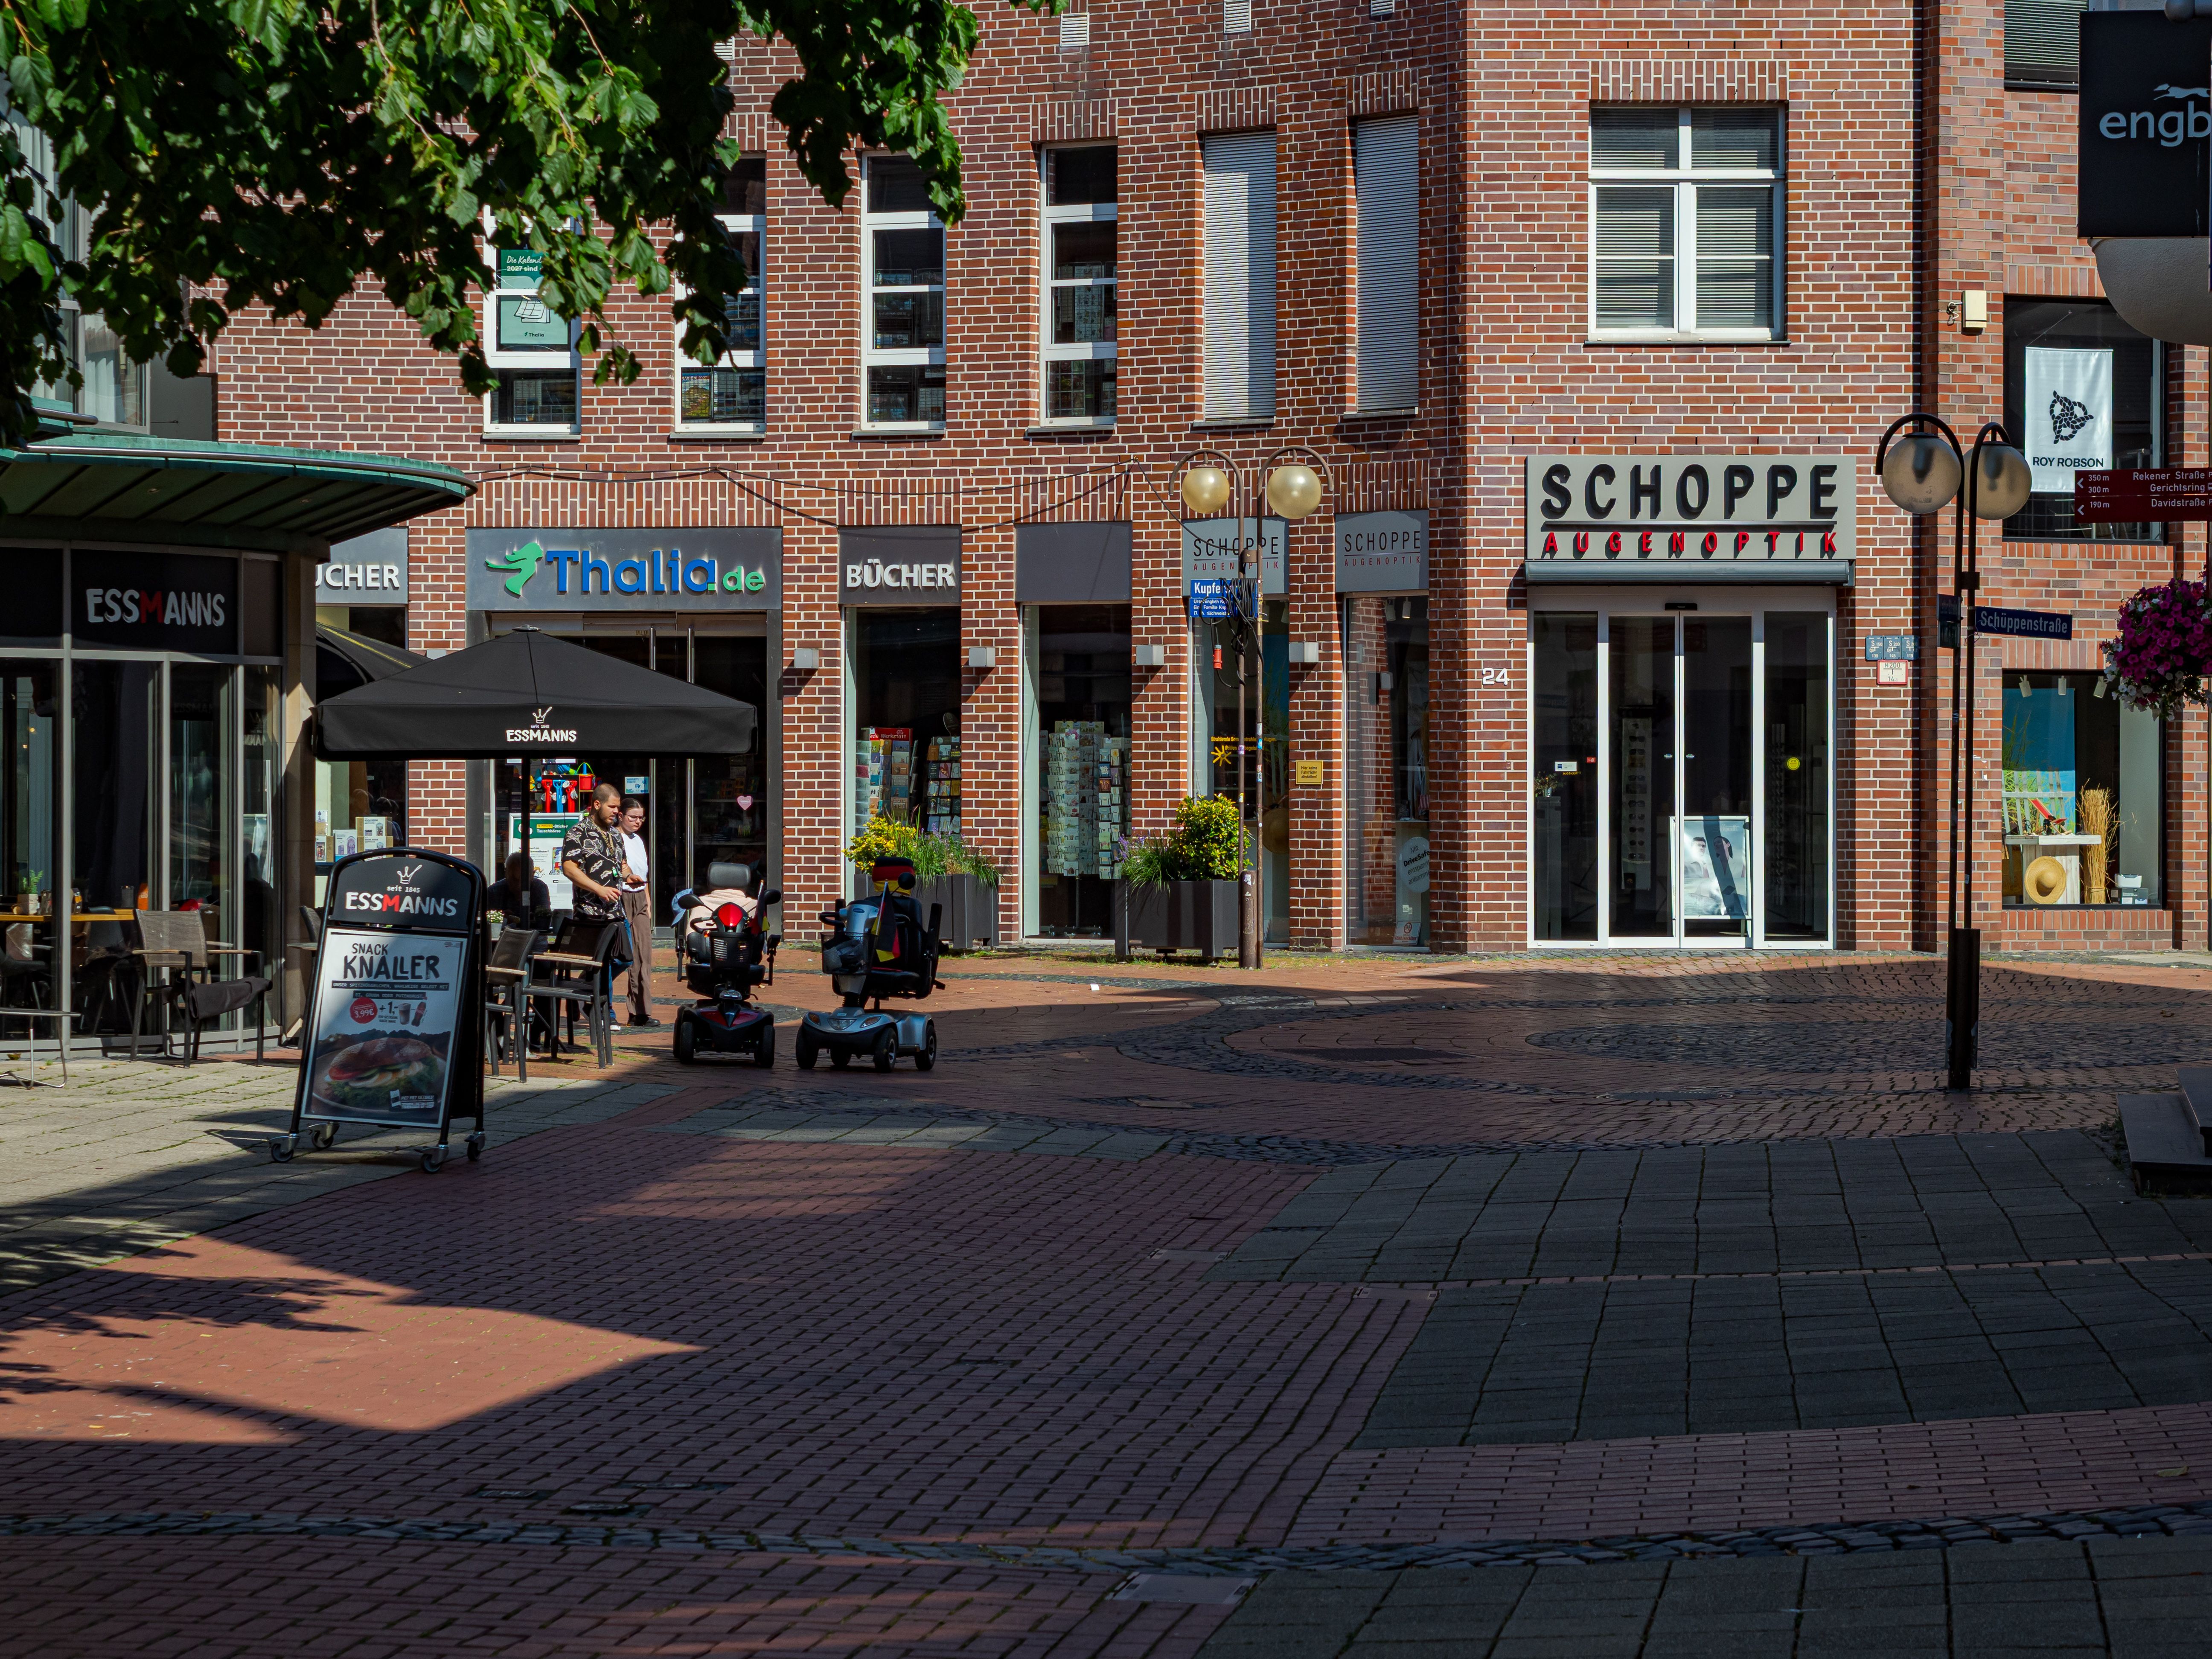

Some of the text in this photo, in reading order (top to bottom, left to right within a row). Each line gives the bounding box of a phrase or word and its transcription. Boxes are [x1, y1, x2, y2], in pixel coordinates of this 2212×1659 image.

[518, 256, 542, 264] Kalend
[2032, 457, 2104, 468] ROY ROBSON
[2133, 472, 2171, 480] Rekener
[2175, 471, 2205, 479] Straße
[1542, 463, 1838, 515] SCHOPPE
[2150, 483, 2205, 493] Gerichtsring
[2151, 498, 2205, 507] Davidstraße
[1344, 531, 1420, 552] SCHOPPE
[1545, 532, 1837, 553] AUGENOPTIK
[1193, 561, 1278, 570] AUGENPIK
[1345, 556, 1420, 567] AUGENOPTIK
[315, 564, 400, 587] CHER
[846, 559, 956, 588] BÜCHER
[86, 588, 225, 627] ESSMANNS
[1981, 611, 2068, 634] Schüppenstraße
[1481, 667, 1509, 686] 24
[506, 729, 577, 742] ESSMANNS
[1410, 845, 1419, 853] Mit
[1403, 850, 1430, 867] DriveSafe
[345, 892, 458, 916] ESSMANNS
[352, 943, 389, 955] SNACK
[343, 955, 440, 980] KNALLER
